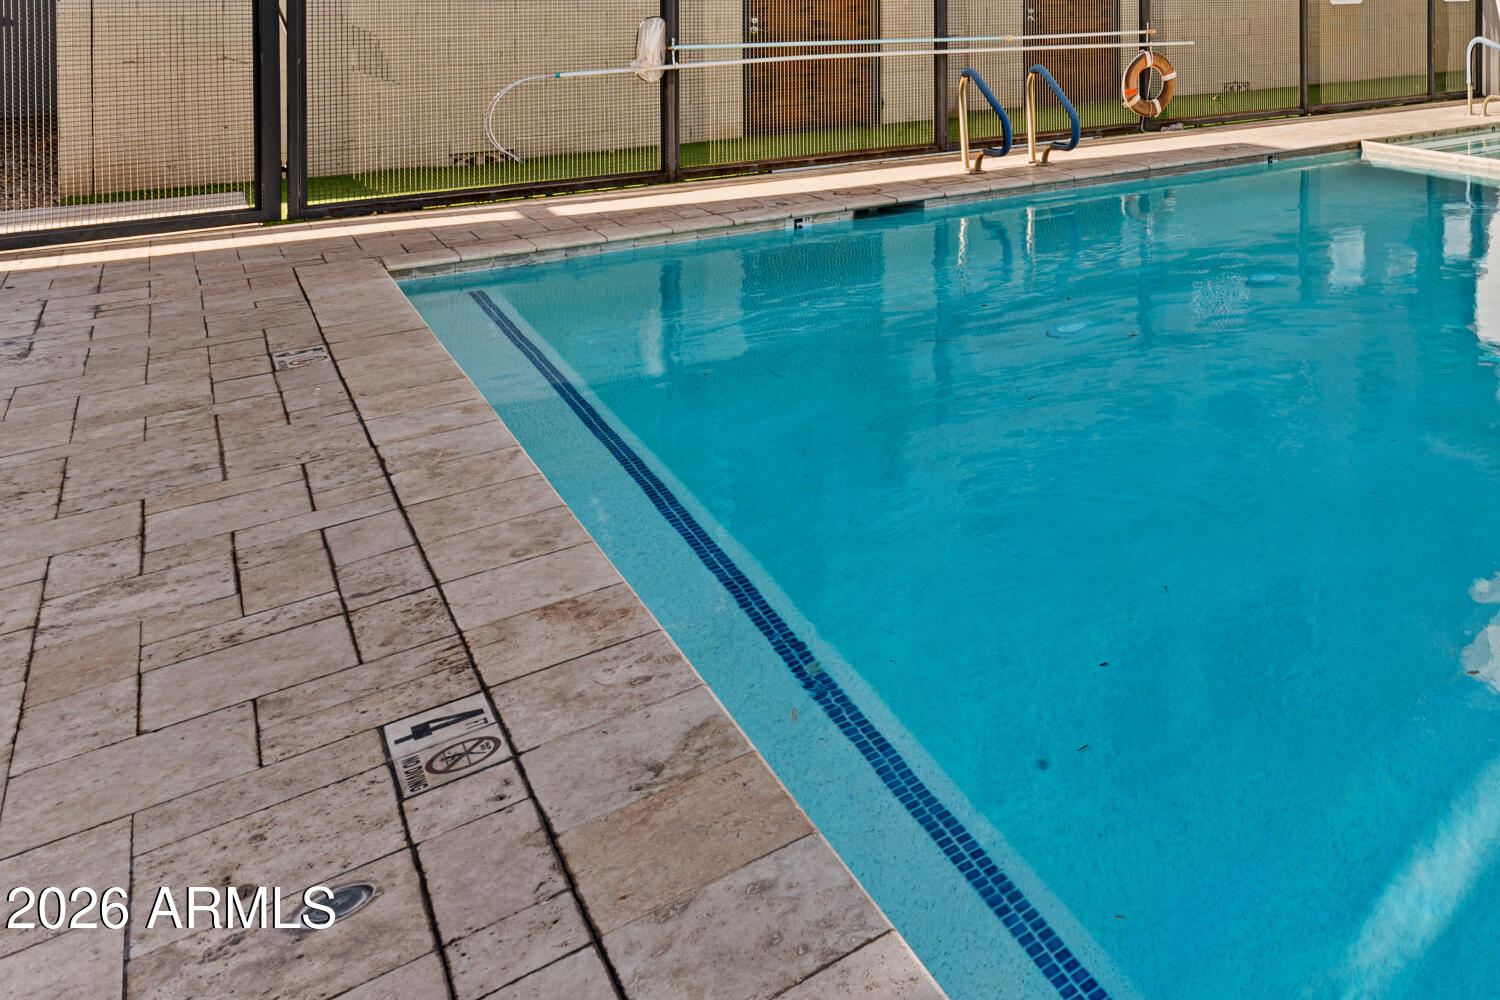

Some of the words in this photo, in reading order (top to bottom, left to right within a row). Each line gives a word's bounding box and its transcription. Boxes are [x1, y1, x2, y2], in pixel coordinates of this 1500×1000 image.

[394, 708, 485, 745] 4
[401, 755, 420, 768] NO
[404, 765, 429, 792] DIVING
